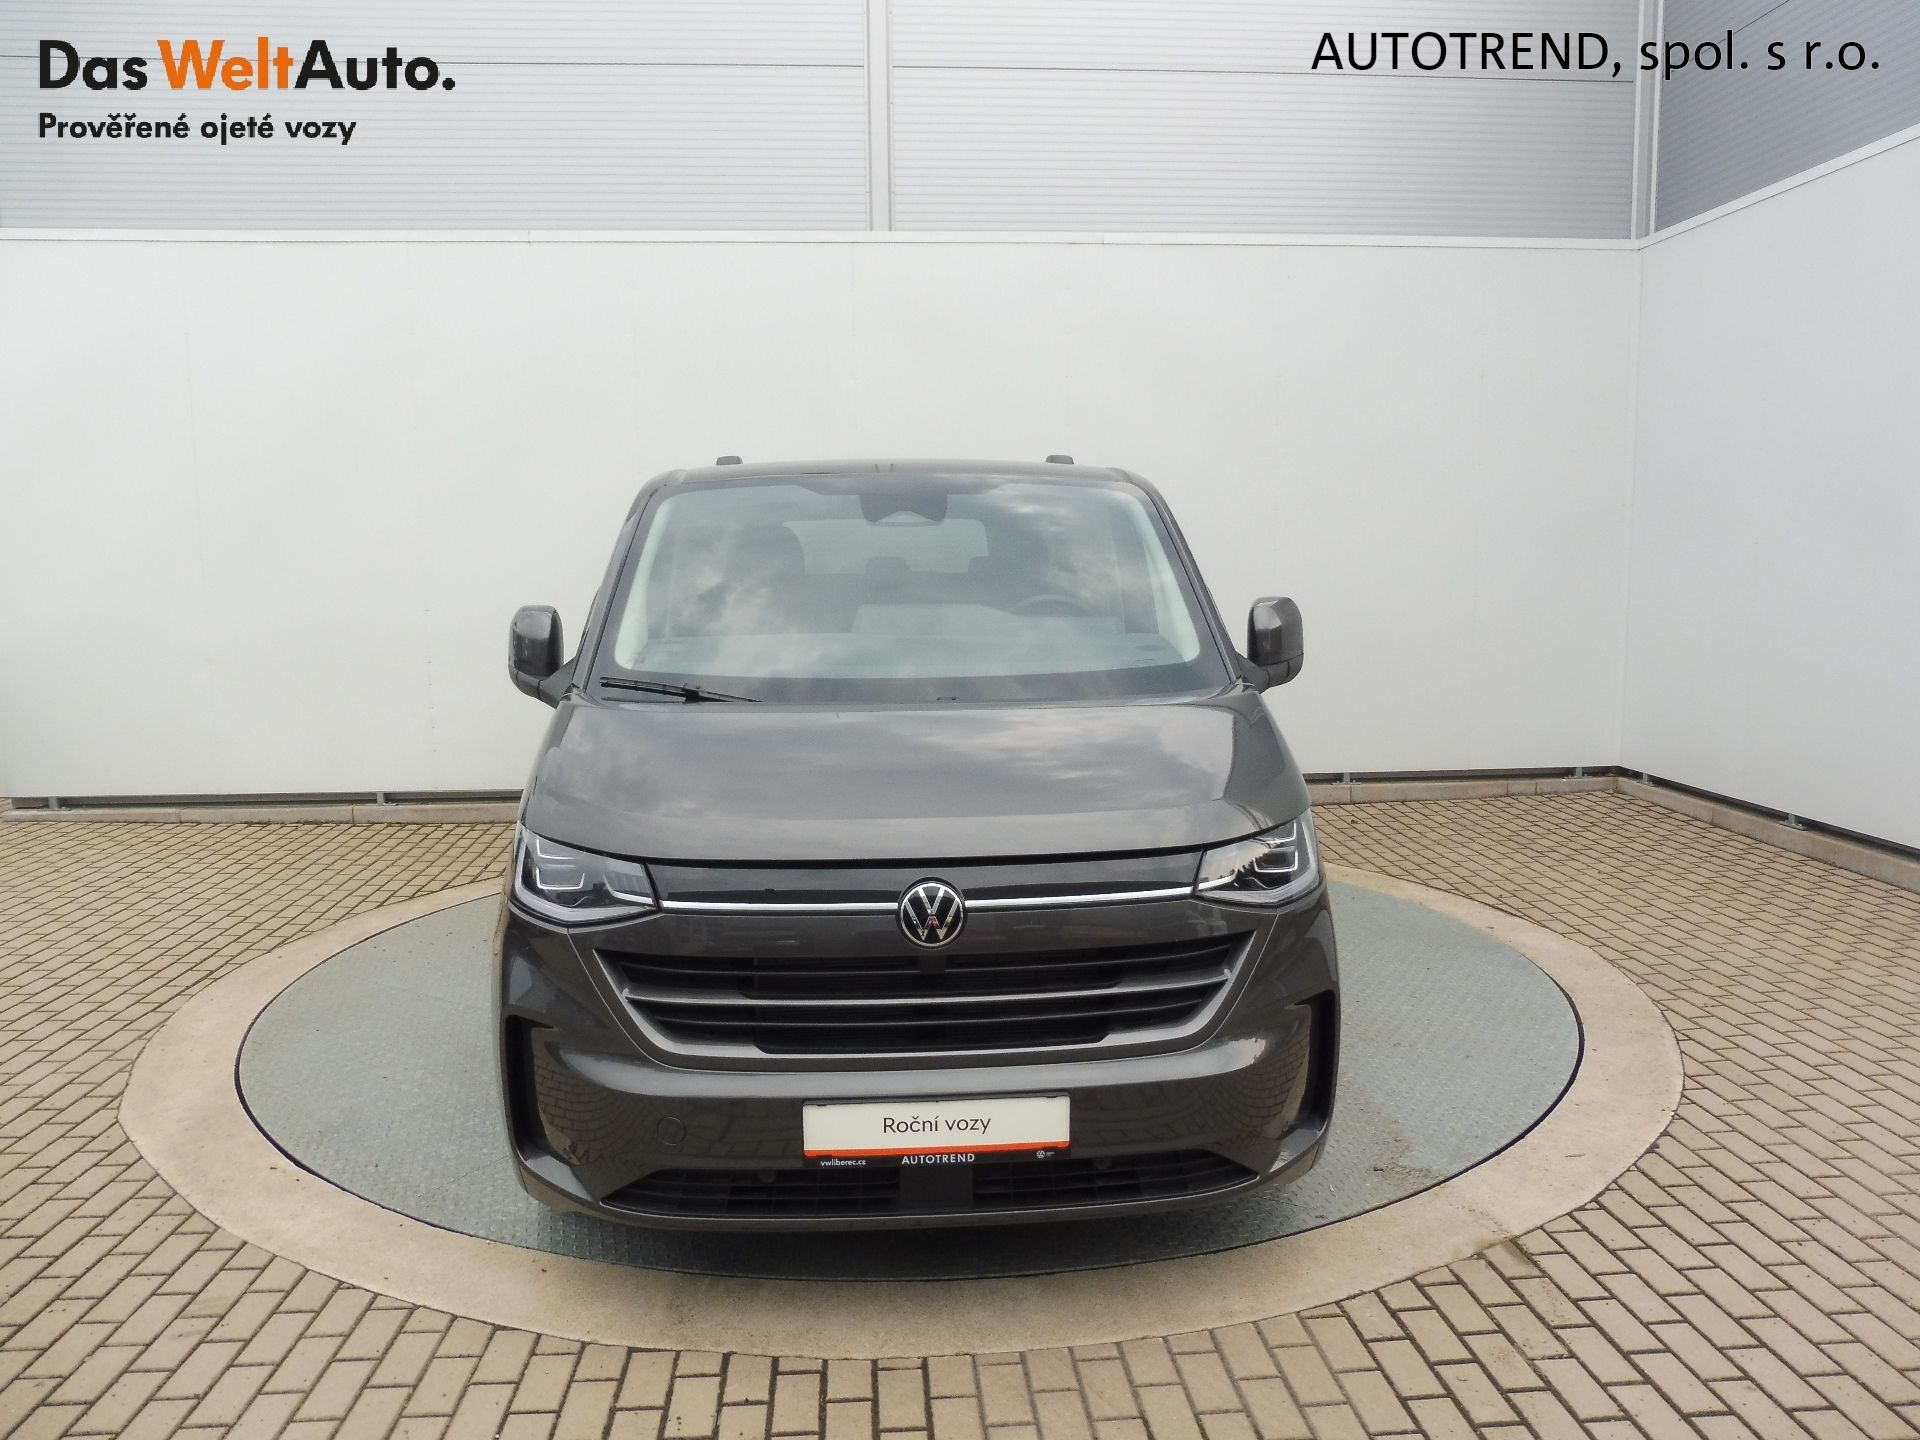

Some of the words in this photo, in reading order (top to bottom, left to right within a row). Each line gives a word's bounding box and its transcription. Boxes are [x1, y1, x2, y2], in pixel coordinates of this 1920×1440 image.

[883, 1115, 939, 1133] Roční
[945, 1117, 991, 1134] vozy
[820, 1158, 866, 1166] vwliberec.cz
[901, 1153, 975, 1165] AUTOTREND
